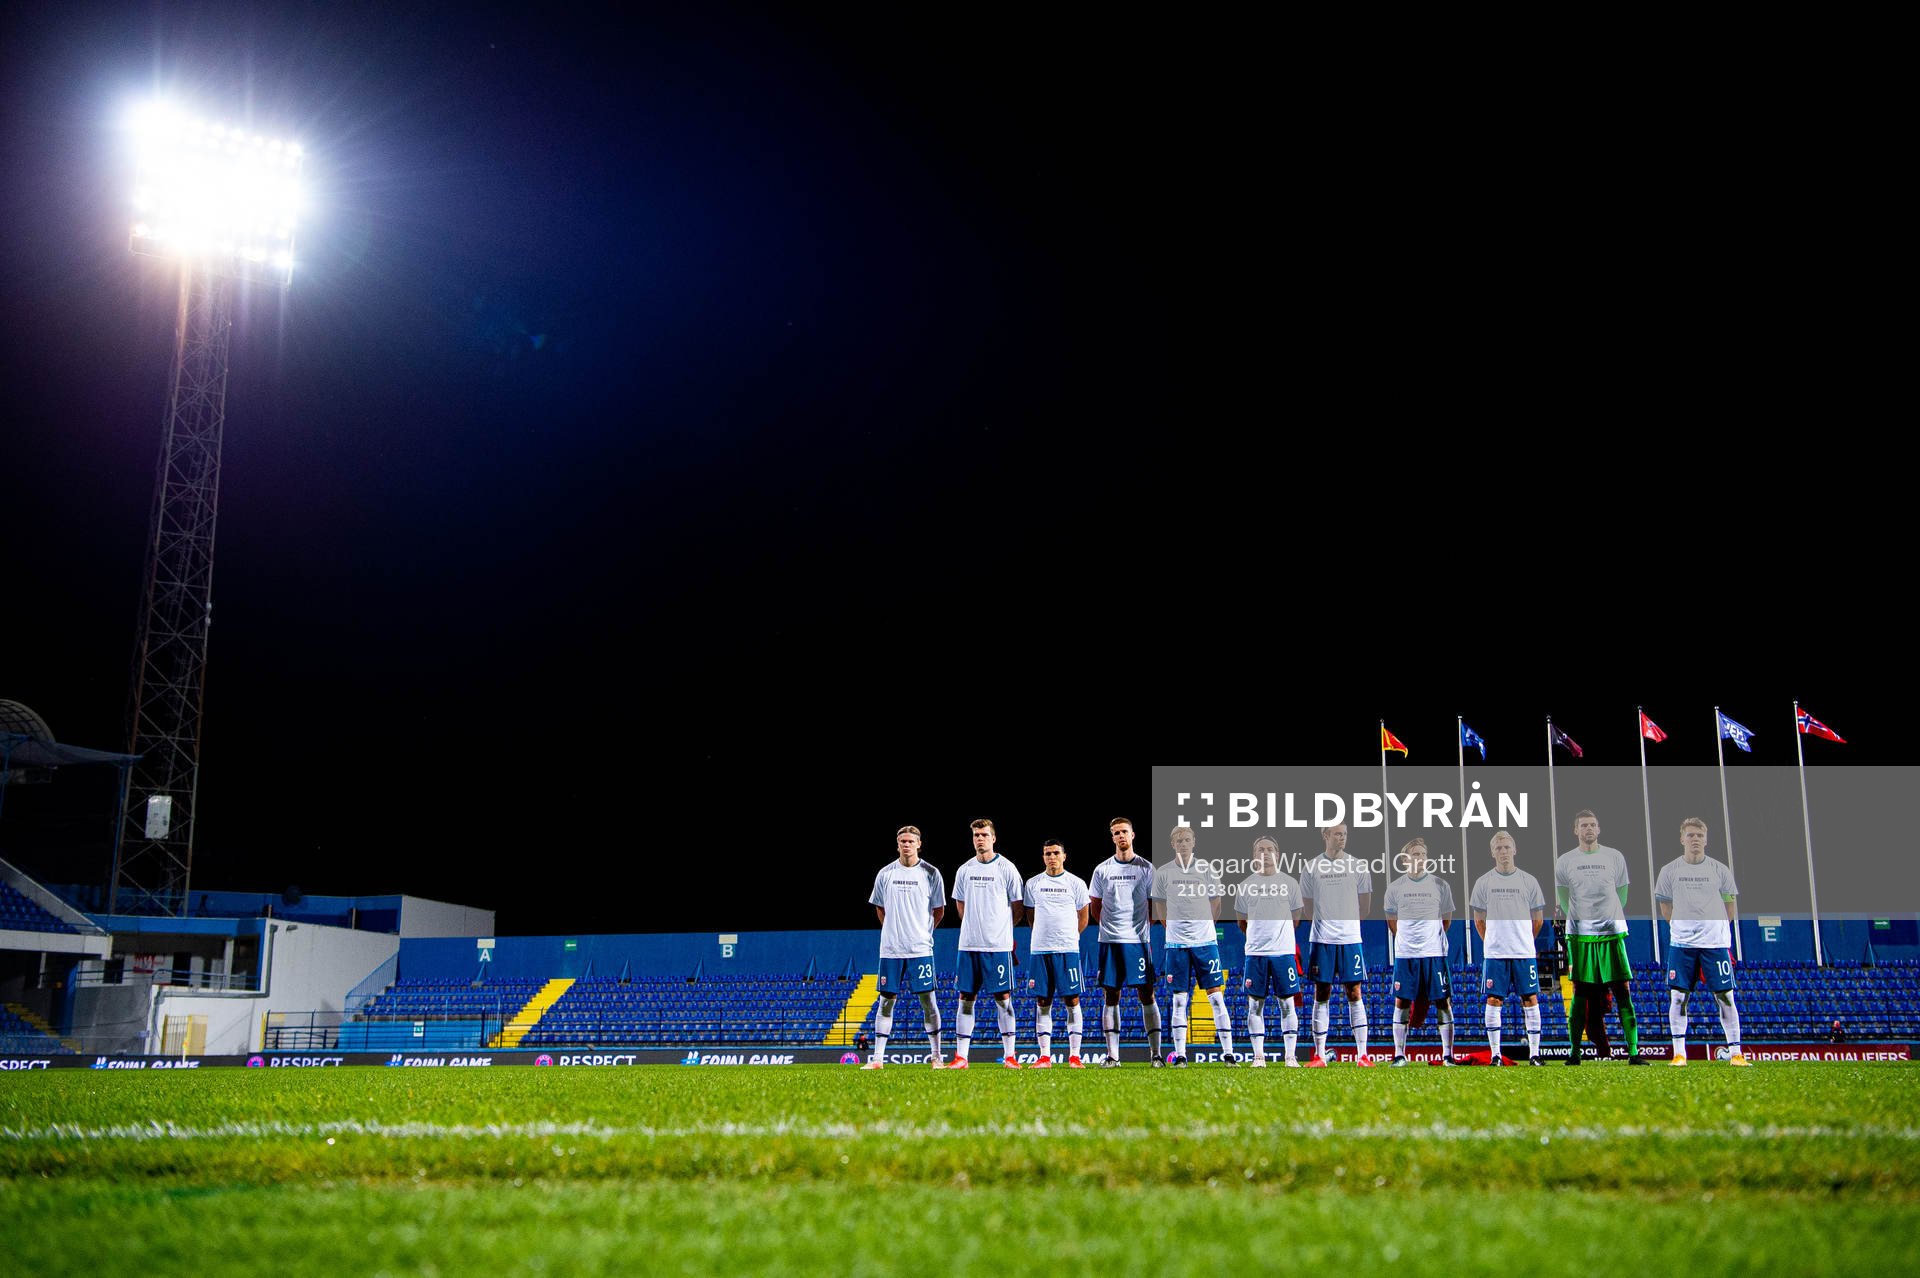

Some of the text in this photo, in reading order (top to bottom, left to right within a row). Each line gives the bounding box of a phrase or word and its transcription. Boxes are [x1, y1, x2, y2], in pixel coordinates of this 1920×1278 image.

[1764, 927, 1776, 942] E
[479, 948, 491, 962] A
[722, 944, 733, 958] B
[1138, 957, 1146, 972] 3
[1208, 958, 1221, 974] 22
[1354, 954, 1361, 969] 2
[1716, 960, 1730, 976] 10
[918, 964, 932, 979] 23
[997, 964, 1005, 979] 9
[1068, 968, 1079, 982] 11
[1287, 967, 1296, 981] 8
[1529, 965, 1537, 980] 5
[1640, 1047, 1665, 1056] 2022
[1743, 1053, 1818, 1062] EUROPEAN
